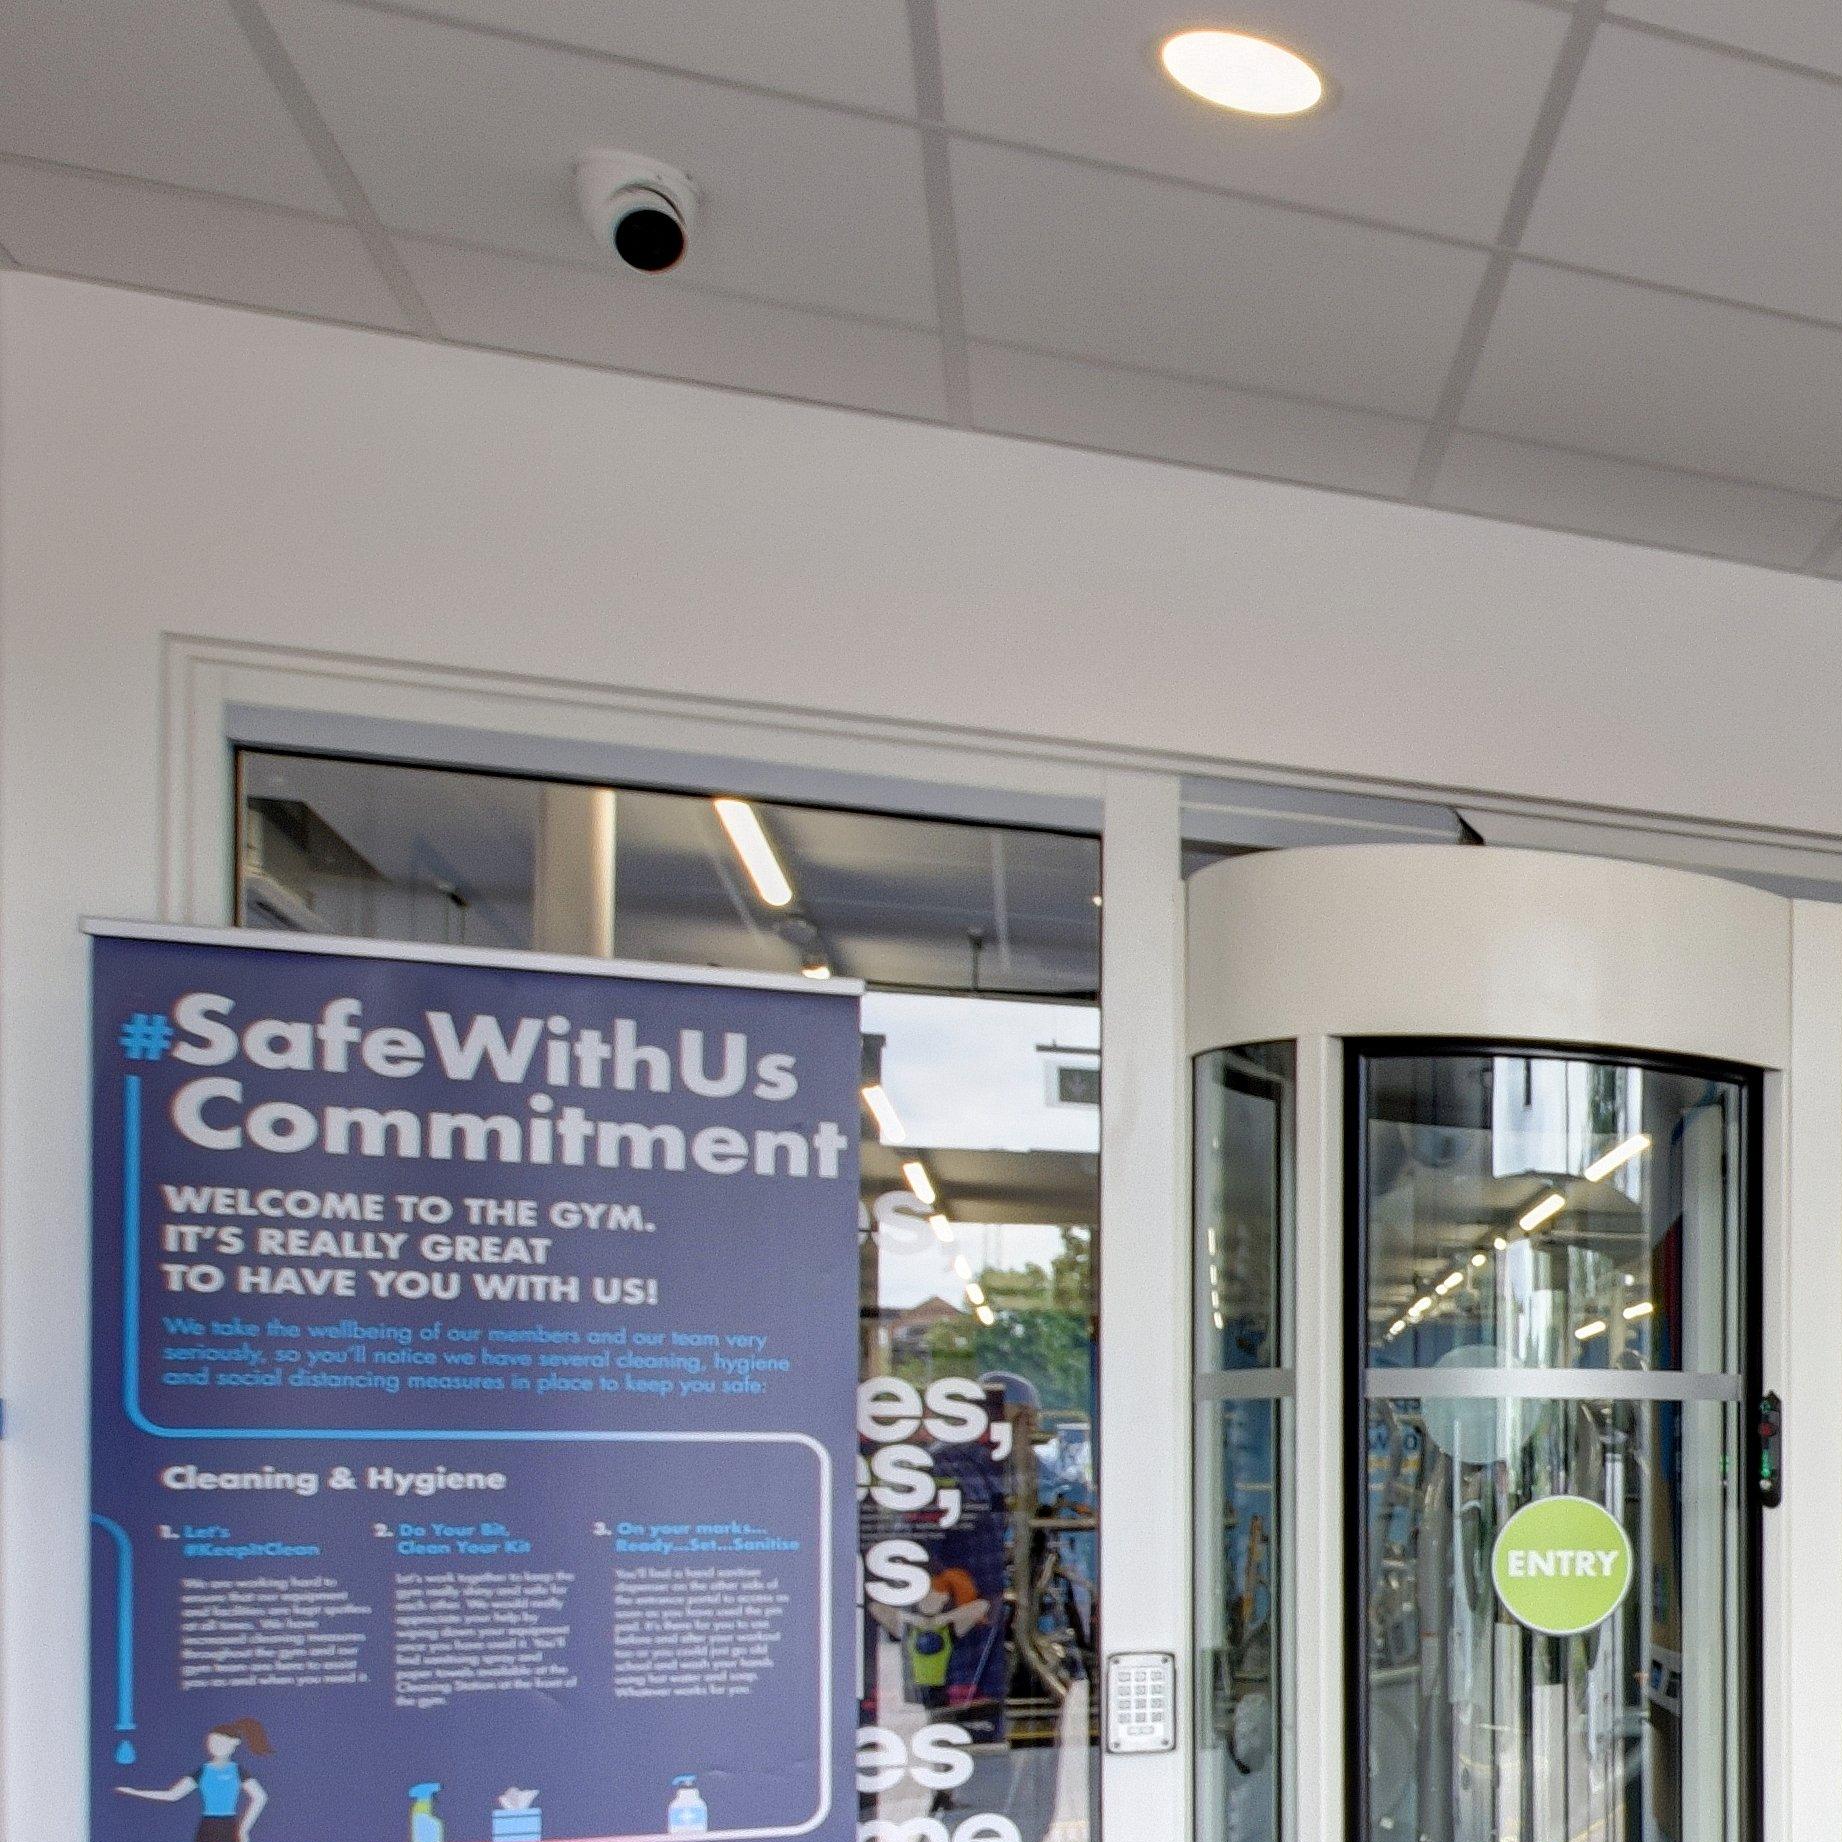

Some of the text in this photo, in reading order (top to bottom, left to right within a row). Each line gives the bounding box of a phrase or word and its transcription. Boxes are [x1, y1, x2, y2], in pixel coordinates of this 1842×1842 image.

[119, 991, 799, 1101] #SafeWithUs
[170, 1075, 848, 1179] Commitment
[161, 1184, 656, 1232] WELCOME TO THE GYM.
[163, 1225, 552, 1264] IT'S REALLY GREAT
[161, 1263, 658, 1304] TO HAVE YOU WITH US!
[162, 1317, 204, 1334] We
[211, 1317, 260, 1335] take
[266, 1318, 300, 1337] the
[308, 1320, 412, 1344] wellbeing
[420, 1321, 442, 1341] of
[587, 1328, 626, 1345] and
[633, 1332, 665, 1346] our
[275, 1350, 300, 1363] so
[373, 1349, 437, 1365] notice
[481, 1348, 532, 1366] have
[539, 1349, 609, 1368] several
[714, 1352, 791, 1375] hygiene
[162, 1367, 209, 1386] and
[216, 1368, 281, 1387] social
[288, 1368, 399, 1393] distancing
[537, 1371, 593, 1396] place
[680, 1379, 714, 1396] you
[161, 1464, 507, 1496] Cleaning & Hygiene
[1508, 1550, 1618, 1577] ENTRY
